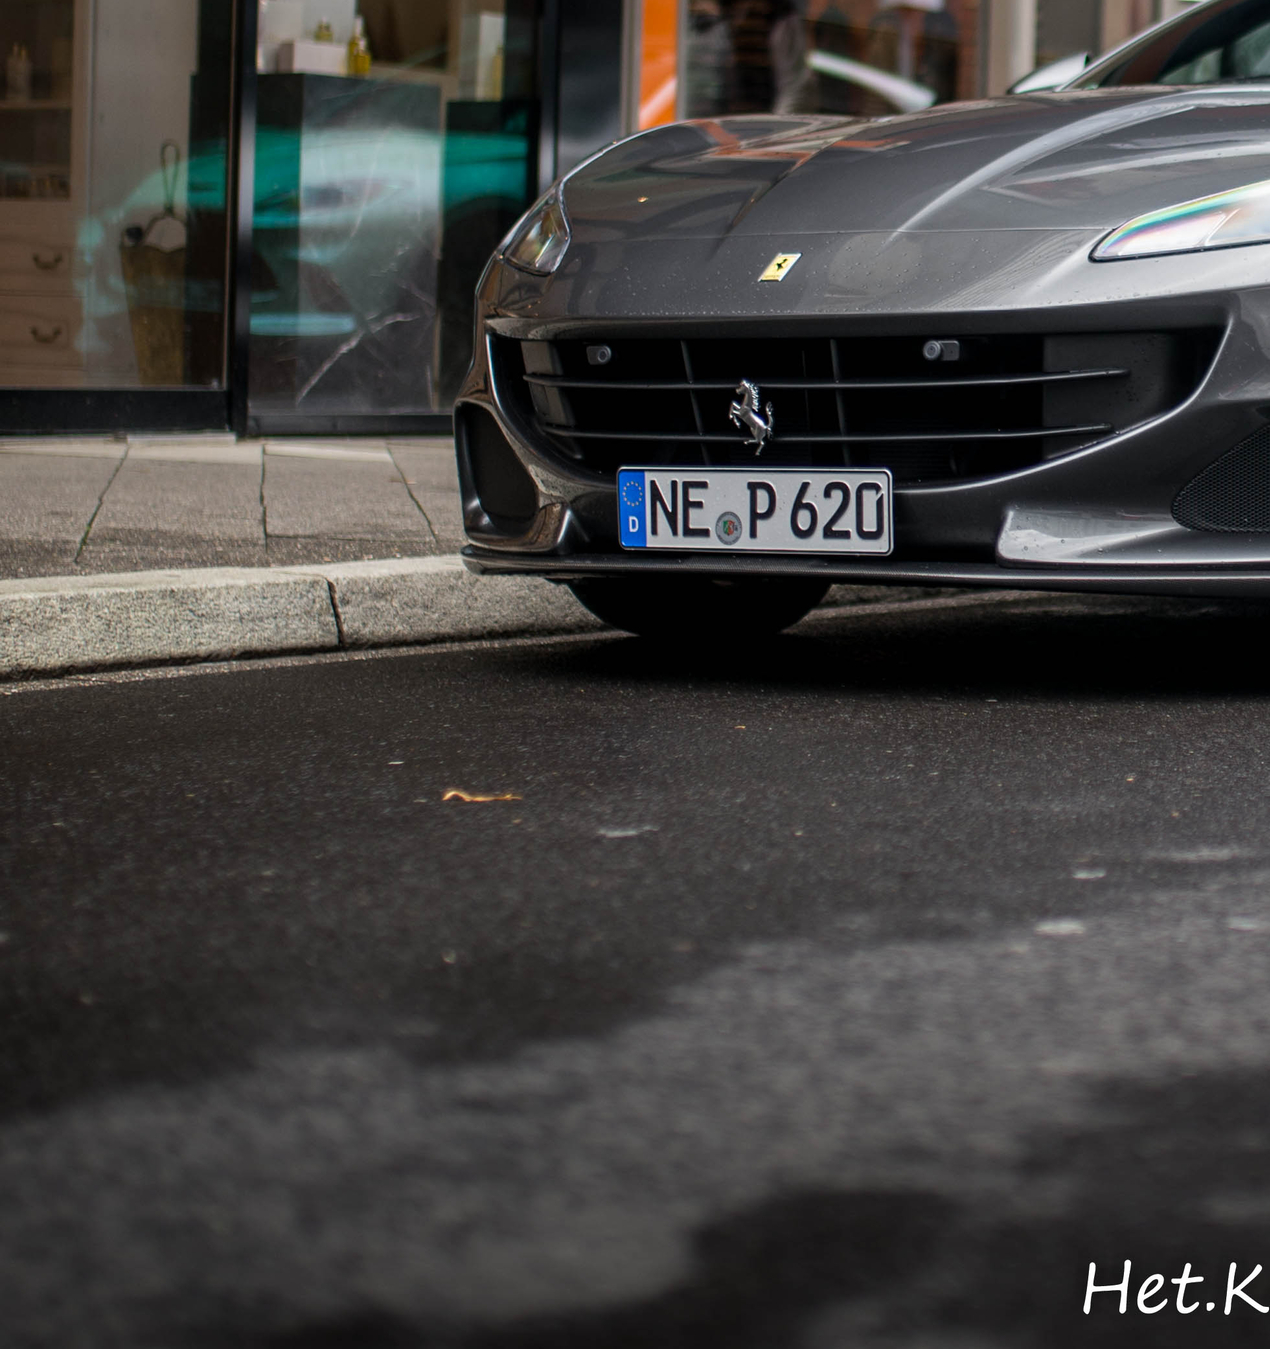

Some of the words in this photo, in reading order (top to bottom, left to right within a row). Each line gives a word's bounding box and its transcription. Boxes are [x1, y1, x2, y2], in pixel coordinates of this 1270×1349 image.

[628, 516, 639, 533] D
[650, 479, 710, 538] NE
[747, 481, 777, 539] P
[790, 481, 885, 540] 620
